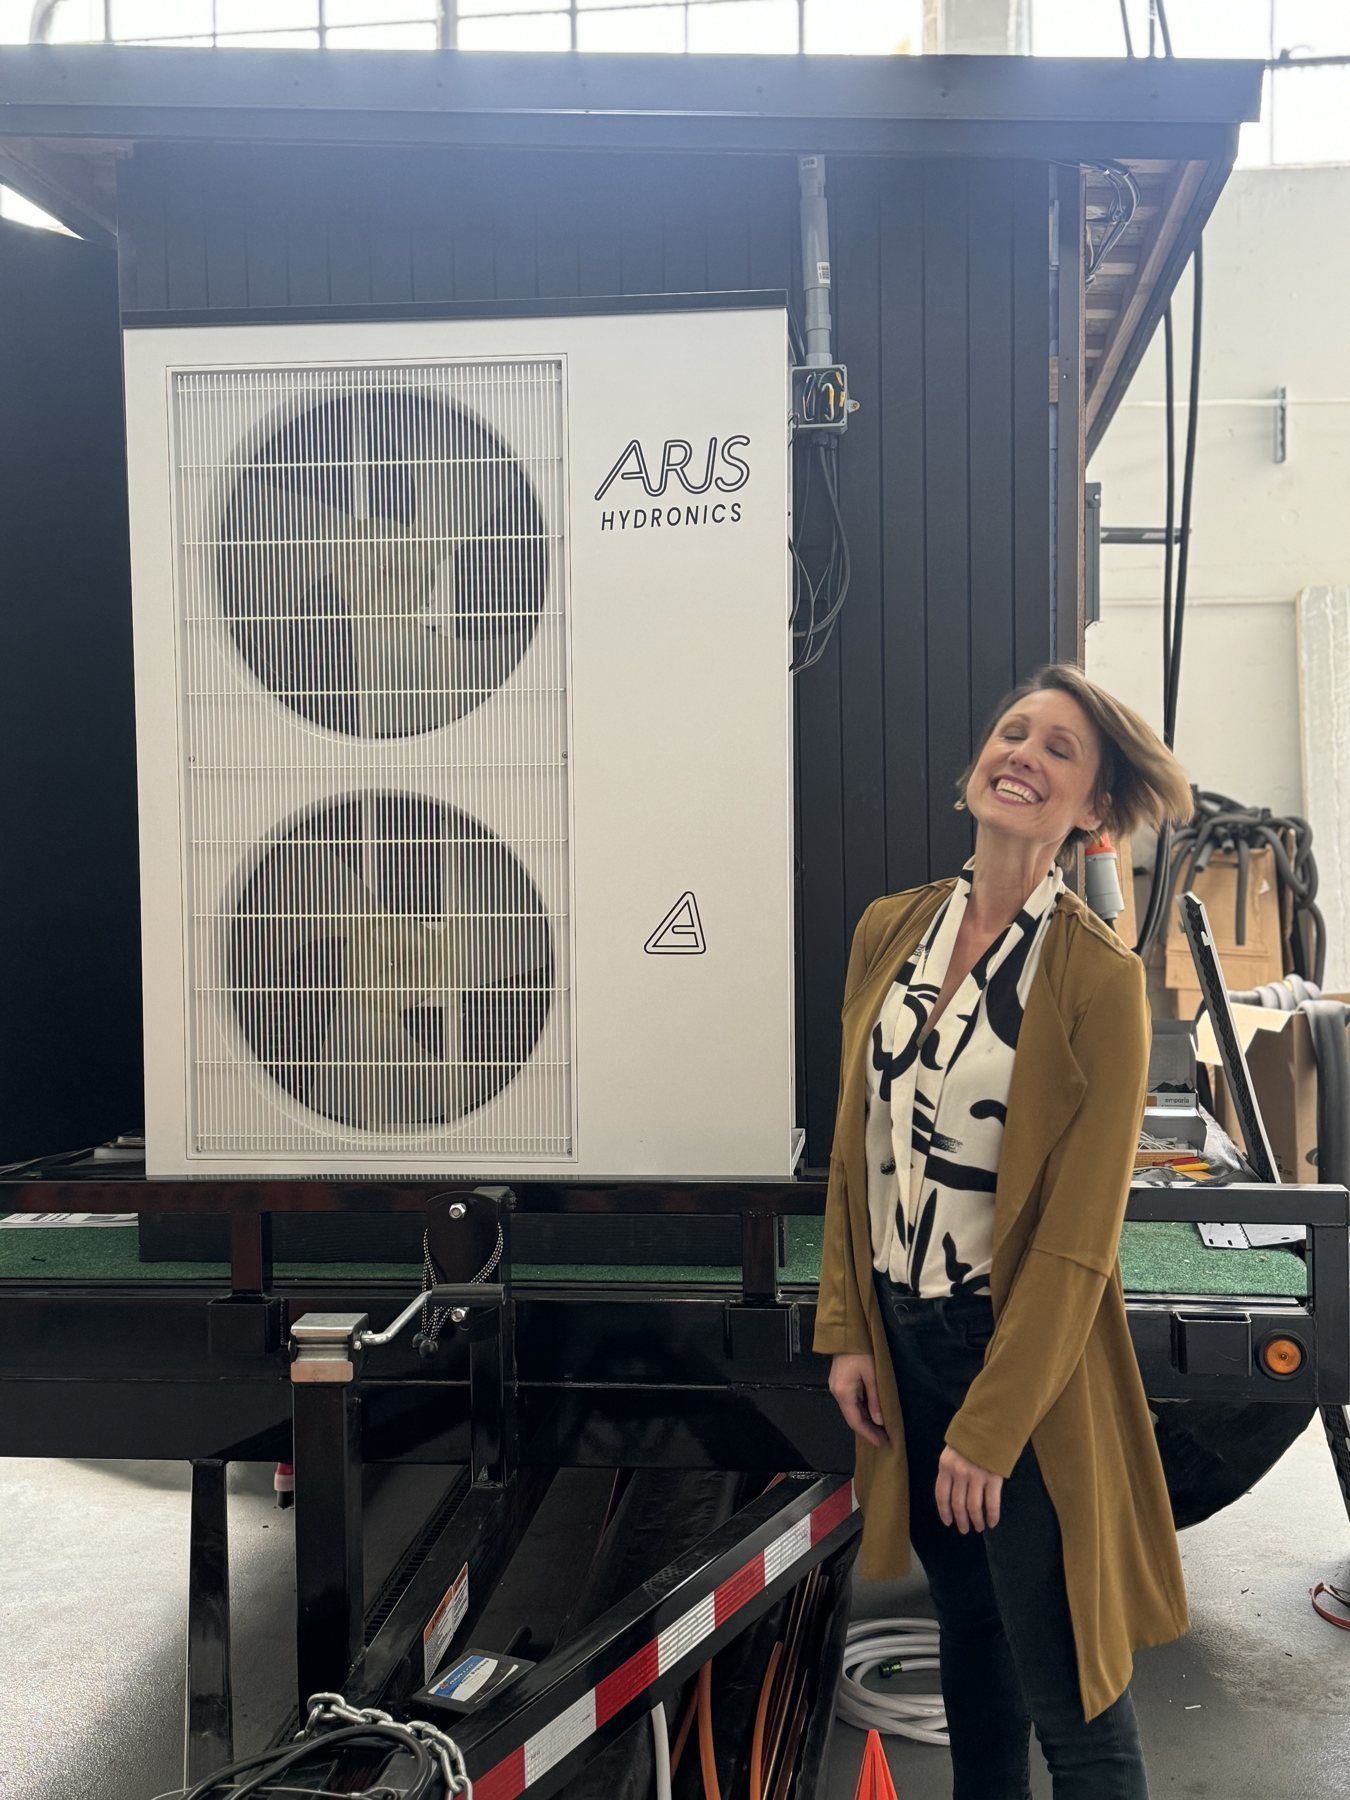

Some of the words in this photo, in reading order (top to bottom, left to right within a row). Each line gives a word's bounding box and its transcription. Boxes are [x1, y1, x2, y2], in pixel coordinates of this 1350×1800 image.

[594, 434, 751, 501] ARIS
[601, 502, 742, 531] HYDRONICS
[1164, 1096, 1190, 1104] emporia
